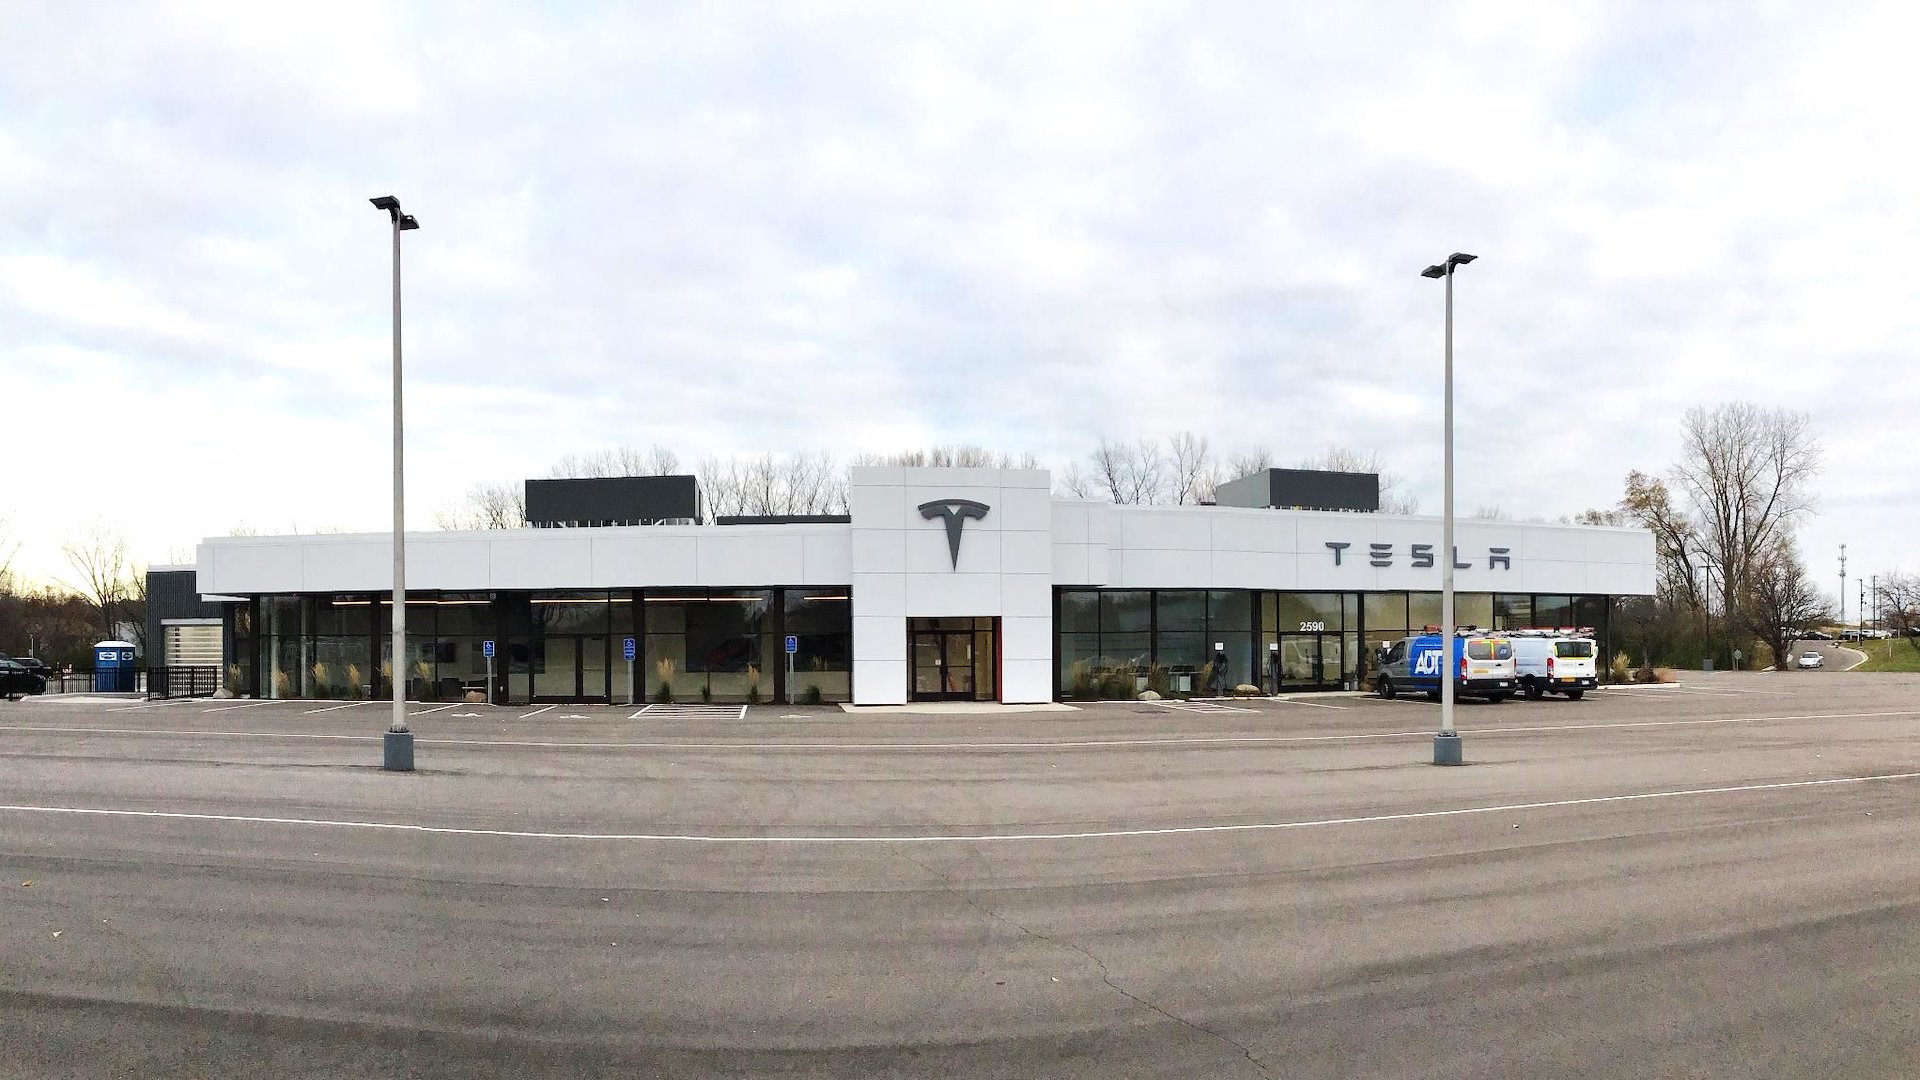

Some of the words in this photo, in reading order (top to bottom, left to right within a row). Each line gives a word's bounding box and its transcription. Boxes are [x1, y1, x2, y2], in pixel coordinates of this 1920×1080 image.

[1325, 542, 1510, 571] TESLA
[1299, 621, 1325, 632] 2590
[1414, 649, 1444, 675] ADT
